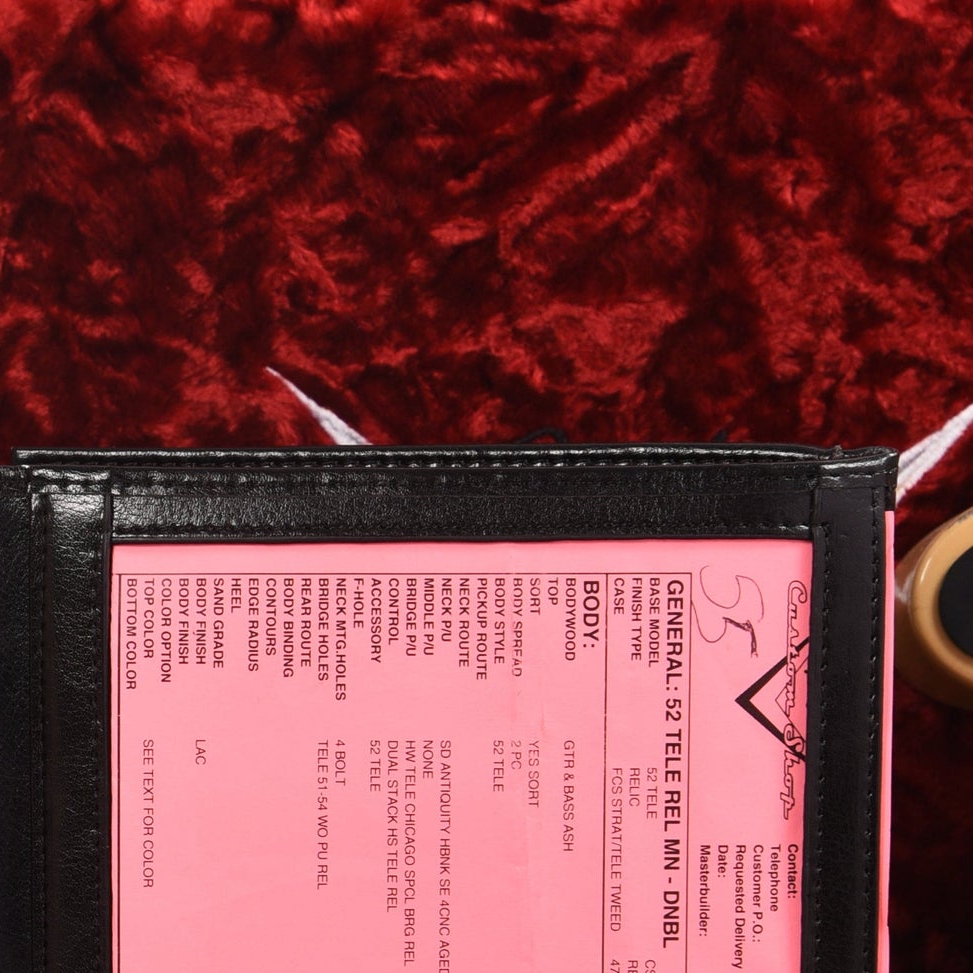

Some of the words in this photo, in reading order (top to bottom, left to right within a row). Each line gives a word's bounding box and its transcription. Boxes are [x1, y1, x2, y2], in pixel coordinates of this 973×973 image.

[441, 578, 452, 615] NECK
[583, 581, 600, 648] BODY:
[614, 578, 625, 614] CASE
[631, 578, 642, 621] FINISH
[650, 578, 660, 614] BASE
[441, 620, 452, 641] P/U
[631, 626, 642, 661] TYPE
[649, 619, 660, 667] MODEL
[666, 580, 684, 690] GENERAL:
[785, 581, 808, 717] Custom
[666, 698, 682, 721] 52
[440, 740, 451, 758] SD
[665, 729, 682, 783] TELE
[612, 768, 622, 794] FCS
[629, 768, 640, 806] RELIC
[647, 768, 657, 782] 52
[780, 724, 803, 820] Shop
[440, 763, 451, 834] ANTIQUITY
[647, 786, 657, 819] TELE
[664, 791, 681, 832] REL
[440, 839, 450, 874] HBNK
[611, 799, 622, 879] STRAT/TELE
[664, 839, 680, 870] MN
[718, 845, 728, 877] Date:
[733, 845, 746, 913] Requested
[753, 845, 764, 907] Customer
[768, 844, 781, 912] Telephone
[787, 844, 798, 898] Contact:
[440, 879, 450, 895] SE
[610, 884, 621, 931] TWEED
[699, 845, 711, 936] Masterbuilder:
[439, 900, 450, 936] 4CNC
[663, 891, 680, 948] DNBL
[752, 912, 763, 942] P.O.:
[731, 918, 745, 969] Delivery
